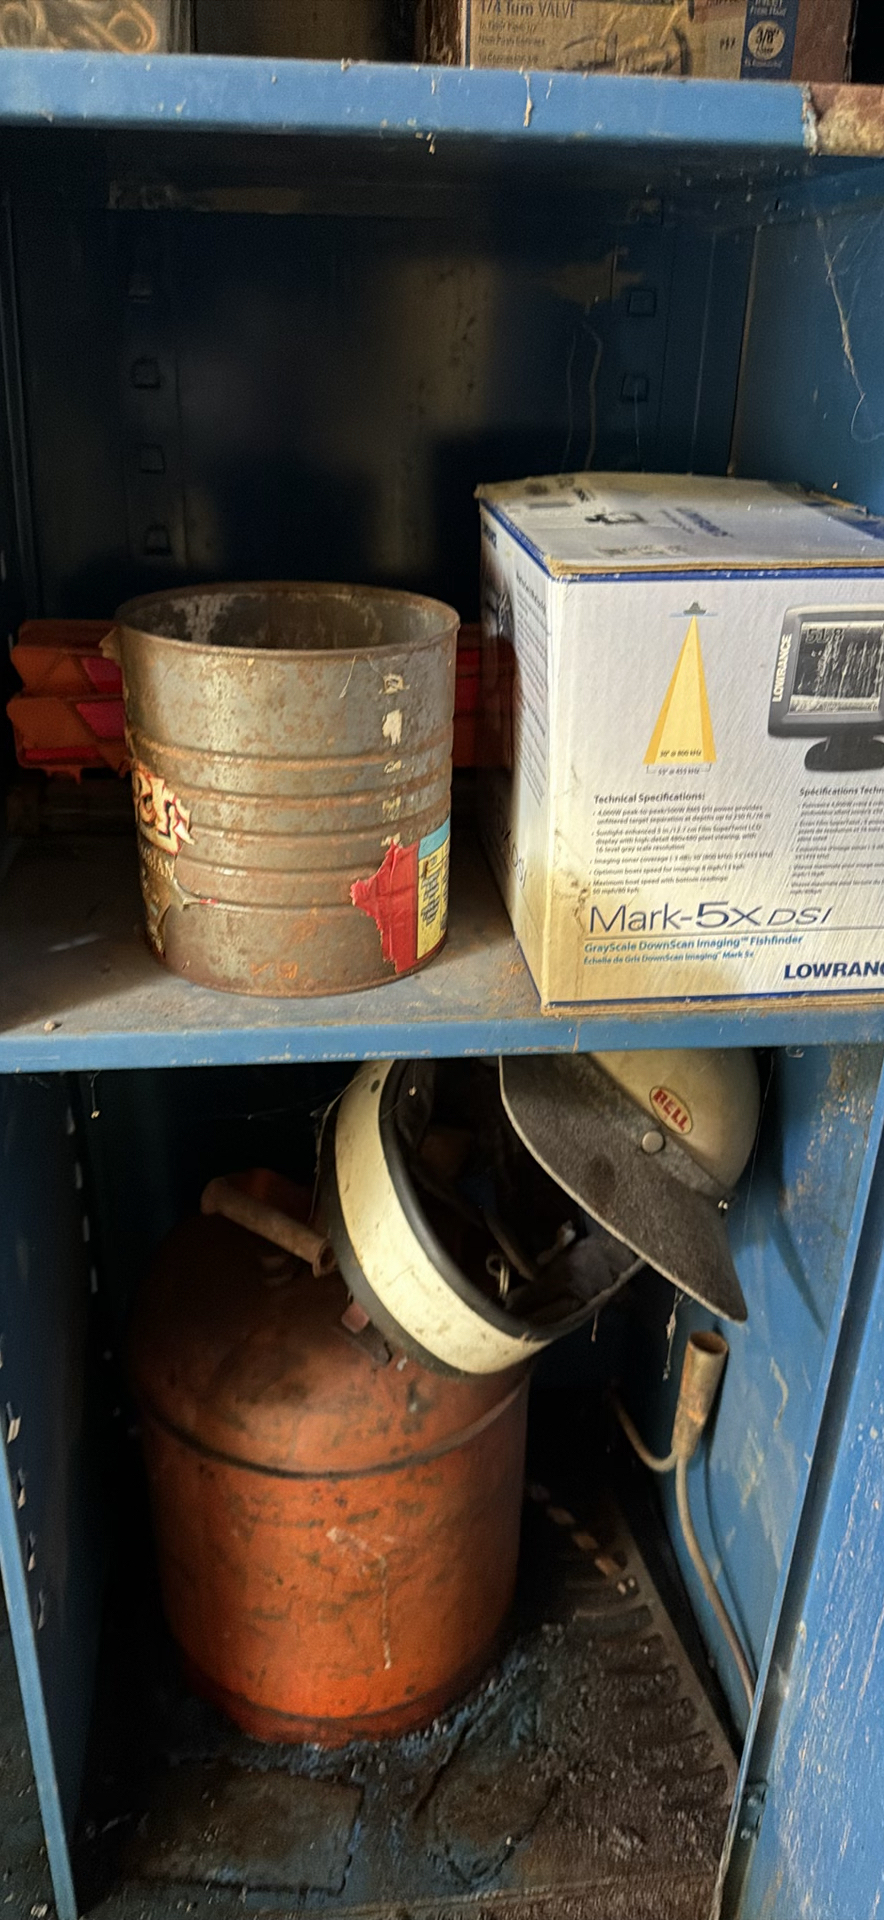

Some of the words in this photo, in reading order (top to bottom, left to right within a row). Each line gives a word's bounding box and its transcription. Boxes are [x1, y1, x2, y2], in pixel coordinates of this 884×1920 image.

[772, 633, 792, 702] LOWRANCE
[594, 794, 637, 804] Technical
[639, 792, 705, 803] Specifications:
[766, 905, 834, 926] DSI
[584, 941, 637, 955] GrayScale
[638, 939, 695, 951] DownScan
[749, 933, 804, 946] Fishfinder
[783, 959, 884, 981] LOWRAN
[653, 1087, 689, 1132] BELL
